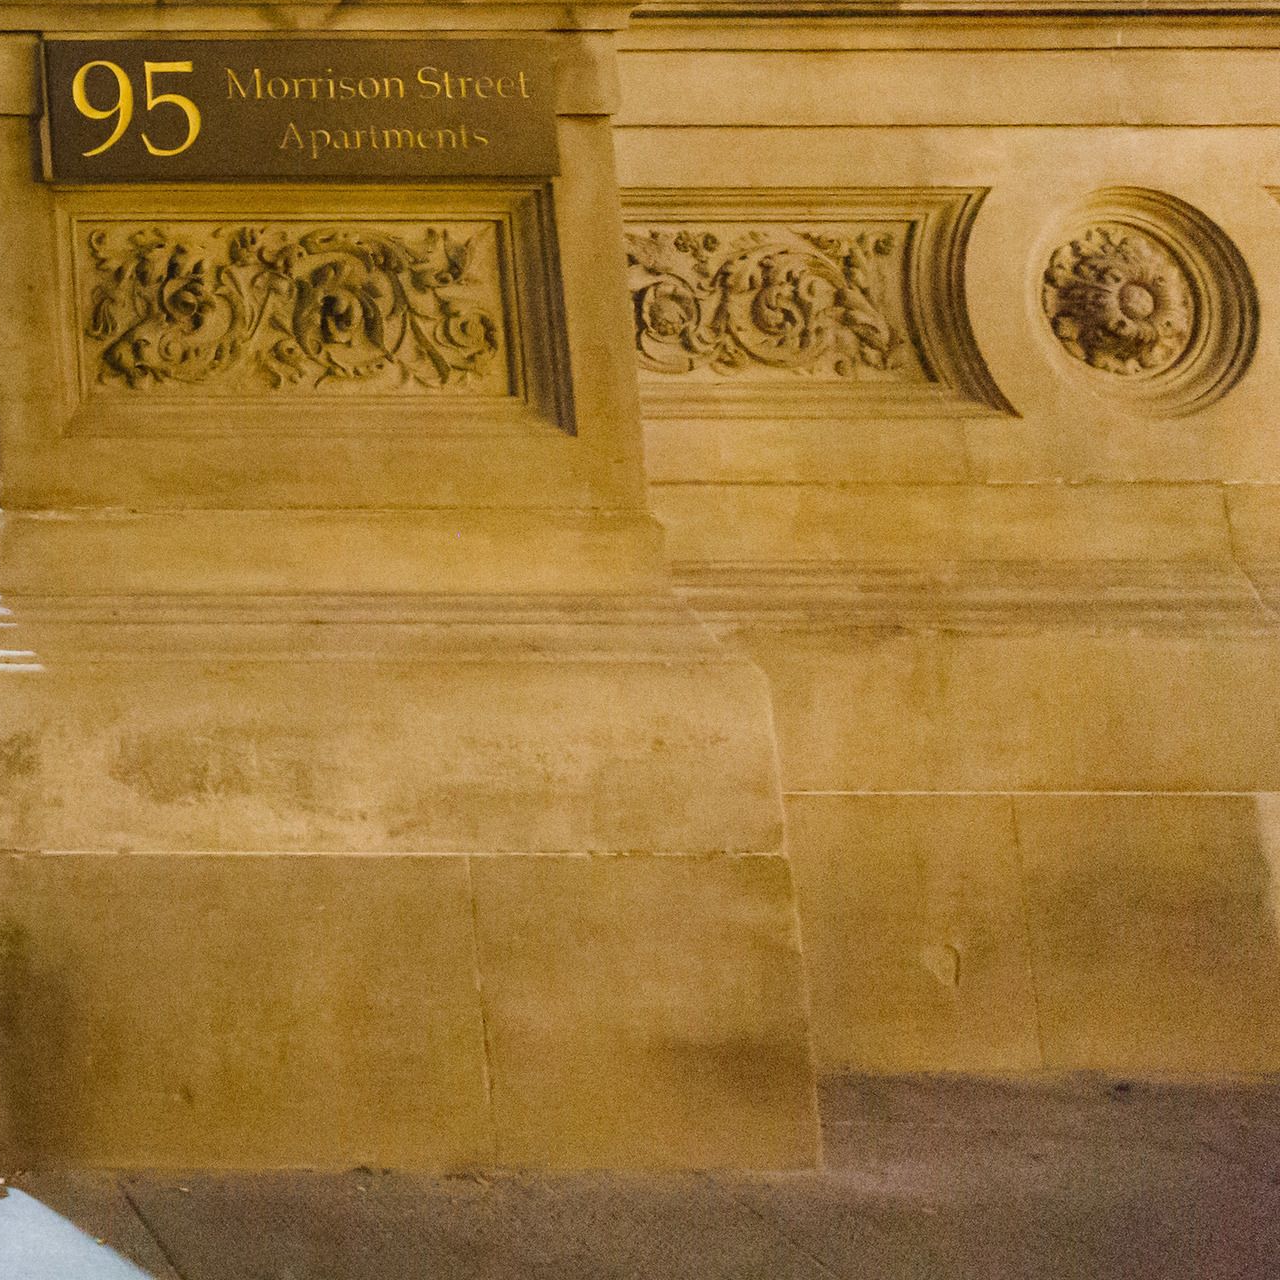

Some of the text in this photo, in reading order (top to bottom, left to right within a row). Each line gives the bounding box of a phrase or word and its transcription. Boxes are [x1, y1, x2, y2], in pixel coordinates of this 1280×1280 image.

[224, 66, 532, 100] Morrison Street
[71, 60, 202, 157] 95
[278, 121, 490, 159] Apartments
